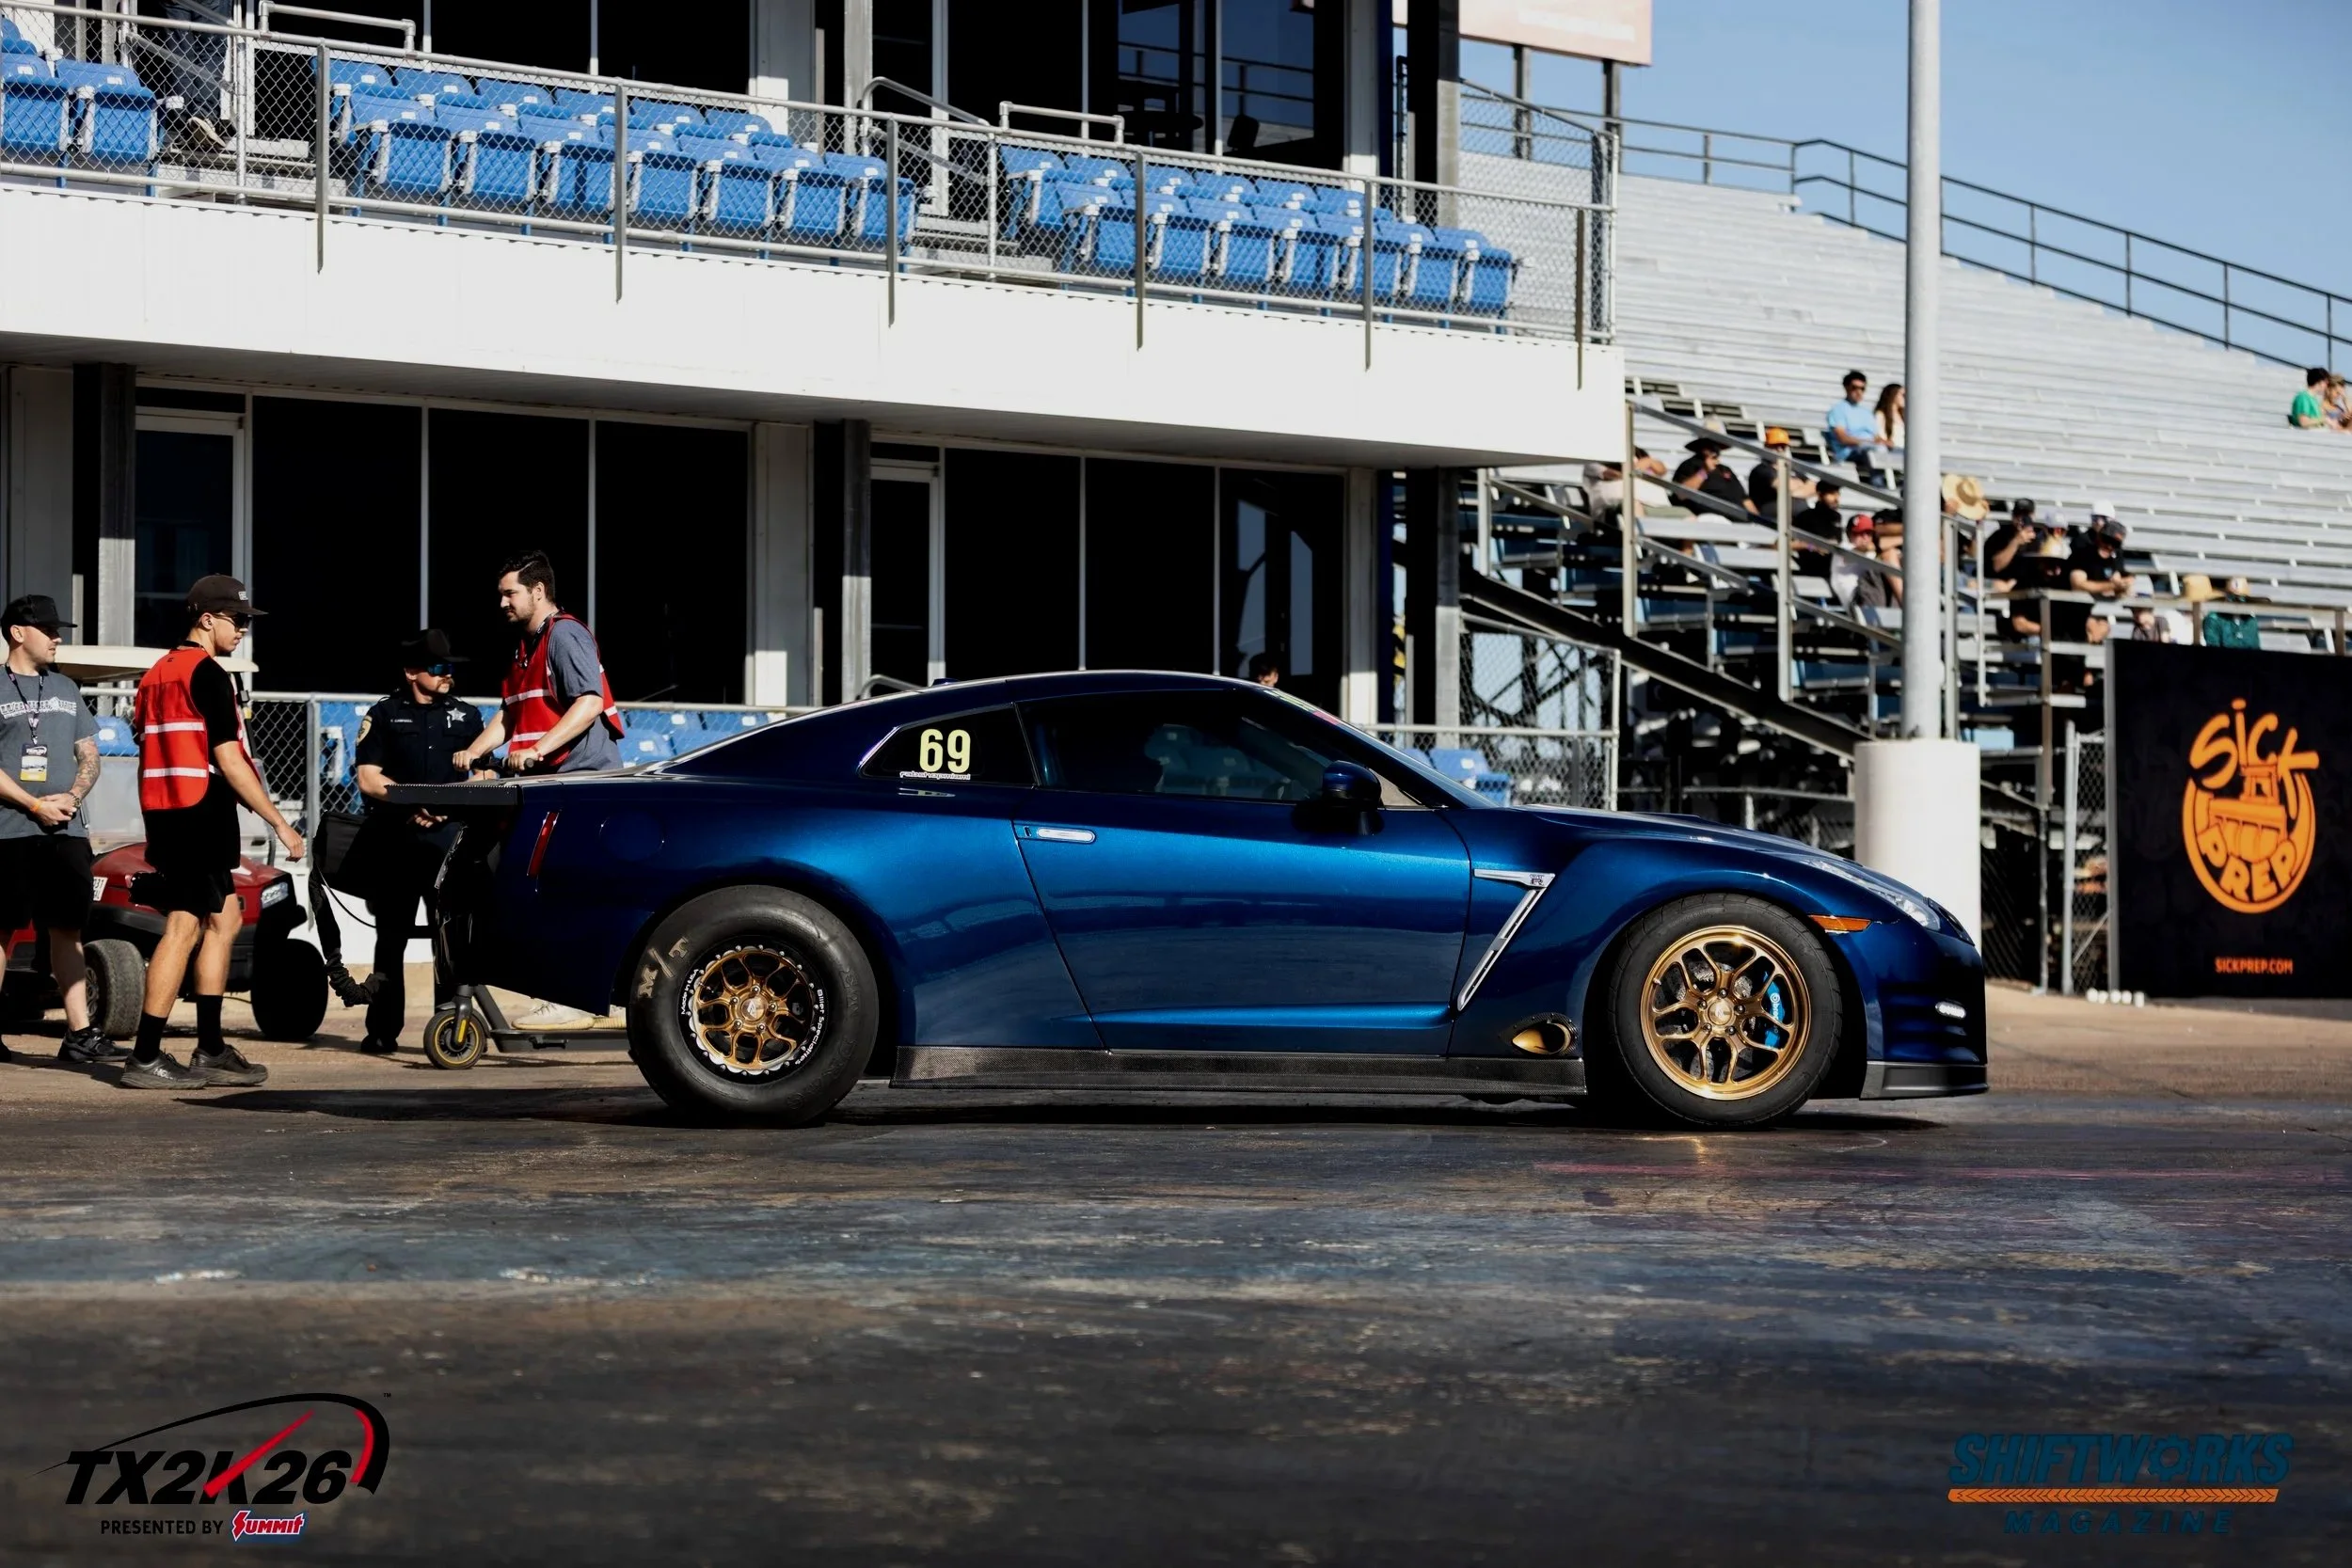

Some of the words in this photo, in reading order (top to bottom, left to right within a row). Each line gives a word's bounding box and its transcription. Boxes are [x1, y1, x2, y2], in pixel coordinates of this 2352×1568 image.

[919, 729, 971, 773] 69
[637, 936, 689, 1000] M/T
[2215, 956, 2294, 974] SICKPREP.COM
